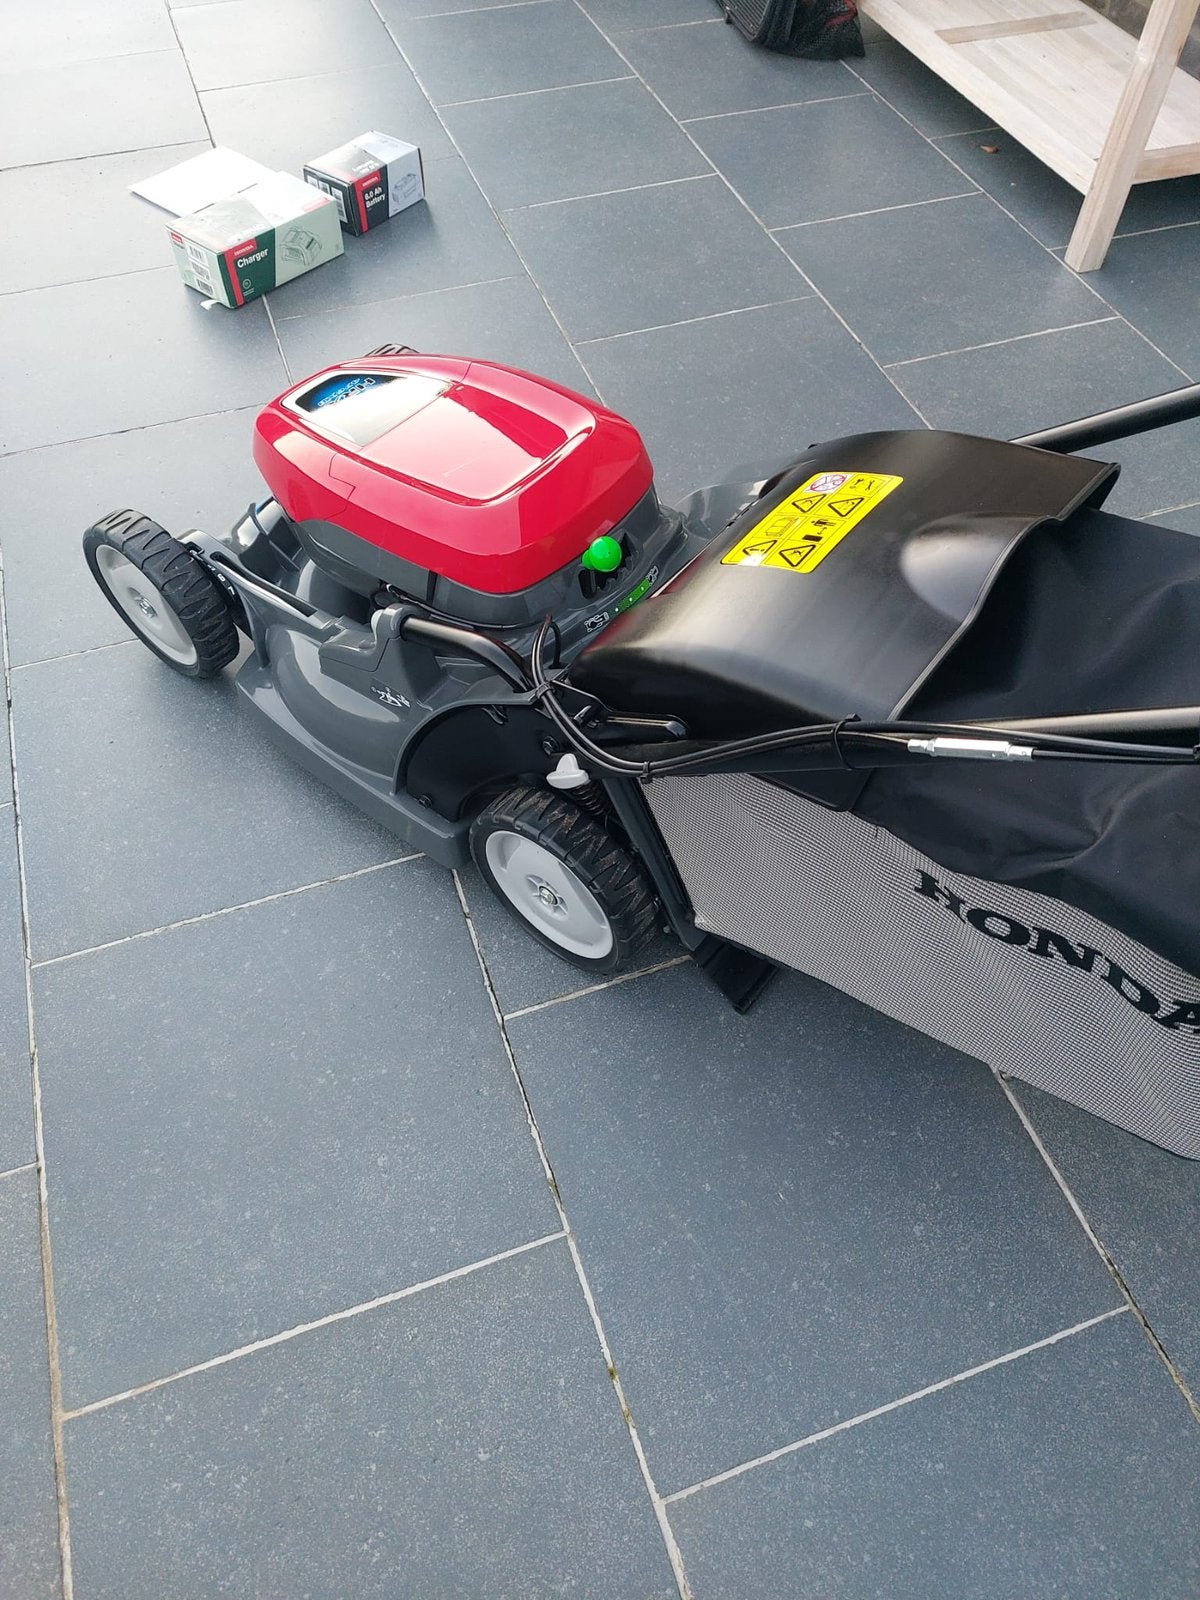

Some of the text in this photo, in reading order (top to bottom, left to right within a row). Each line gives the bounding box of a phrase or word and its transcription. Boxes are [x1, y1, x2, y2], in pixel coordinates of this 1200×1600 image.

[365, 193, 386, 208] Battery
[233, 244, 255, 257] HONDA
[237, 248, 269, 268] Charger
[914, 868, 1200, 1034] HONDA
